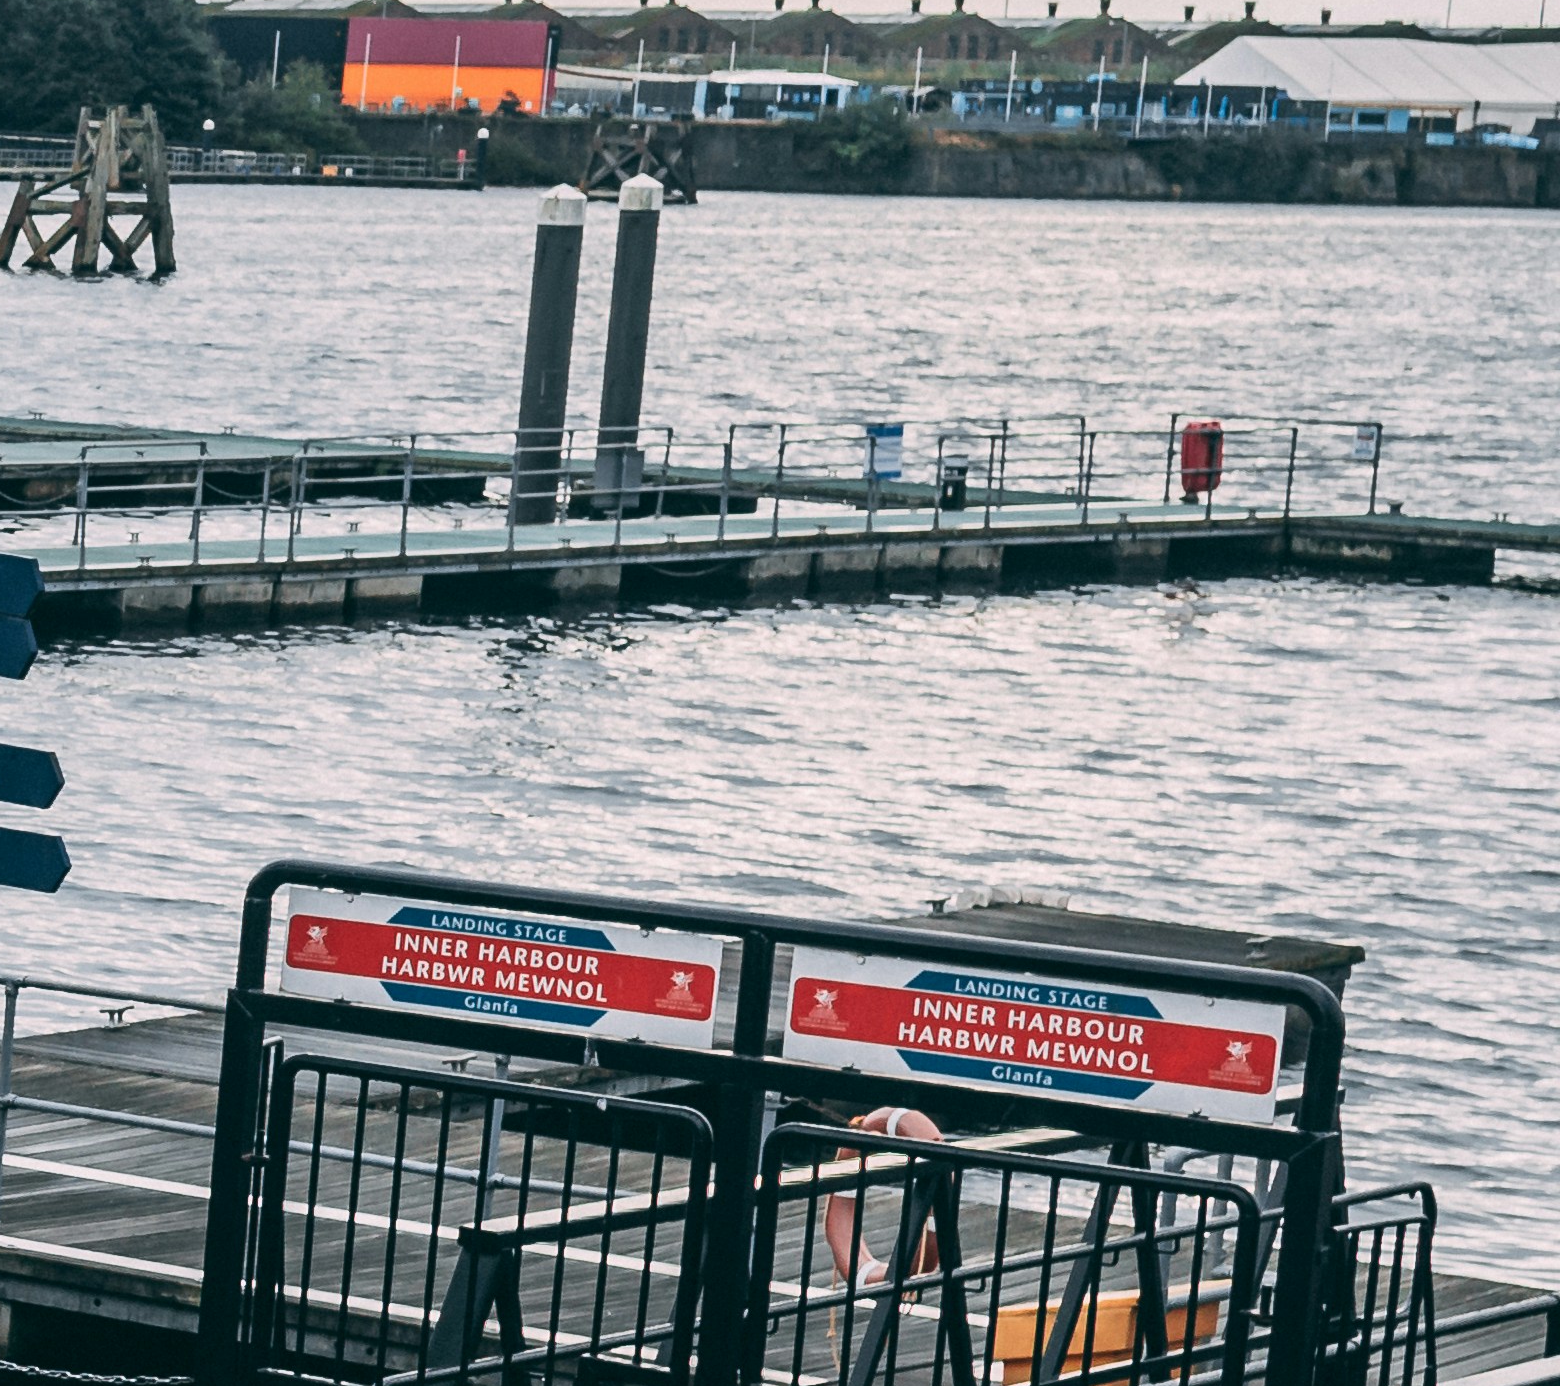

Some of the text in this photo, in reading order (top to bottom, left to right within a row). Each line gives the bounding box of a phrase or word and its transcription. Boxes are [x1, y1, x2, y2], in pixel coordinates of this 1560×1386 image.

[431, 913, 568, 944] LANDING STAGE
[394, 932, 600, 976] INNER HARBOUR
[380, 955, 608, 1004] HARBWR MEWNOL
[954, 978, 1108, 1011] LANDING STAGE
[463, 994, 519, 1016] Glanfa
[912, 996, 1145, 1046] INNER HARBOUR
[897, 1020, 1155, 1075] HARBWR MEWNOL
[991, 1065, 1053, 1086] Glanfa
